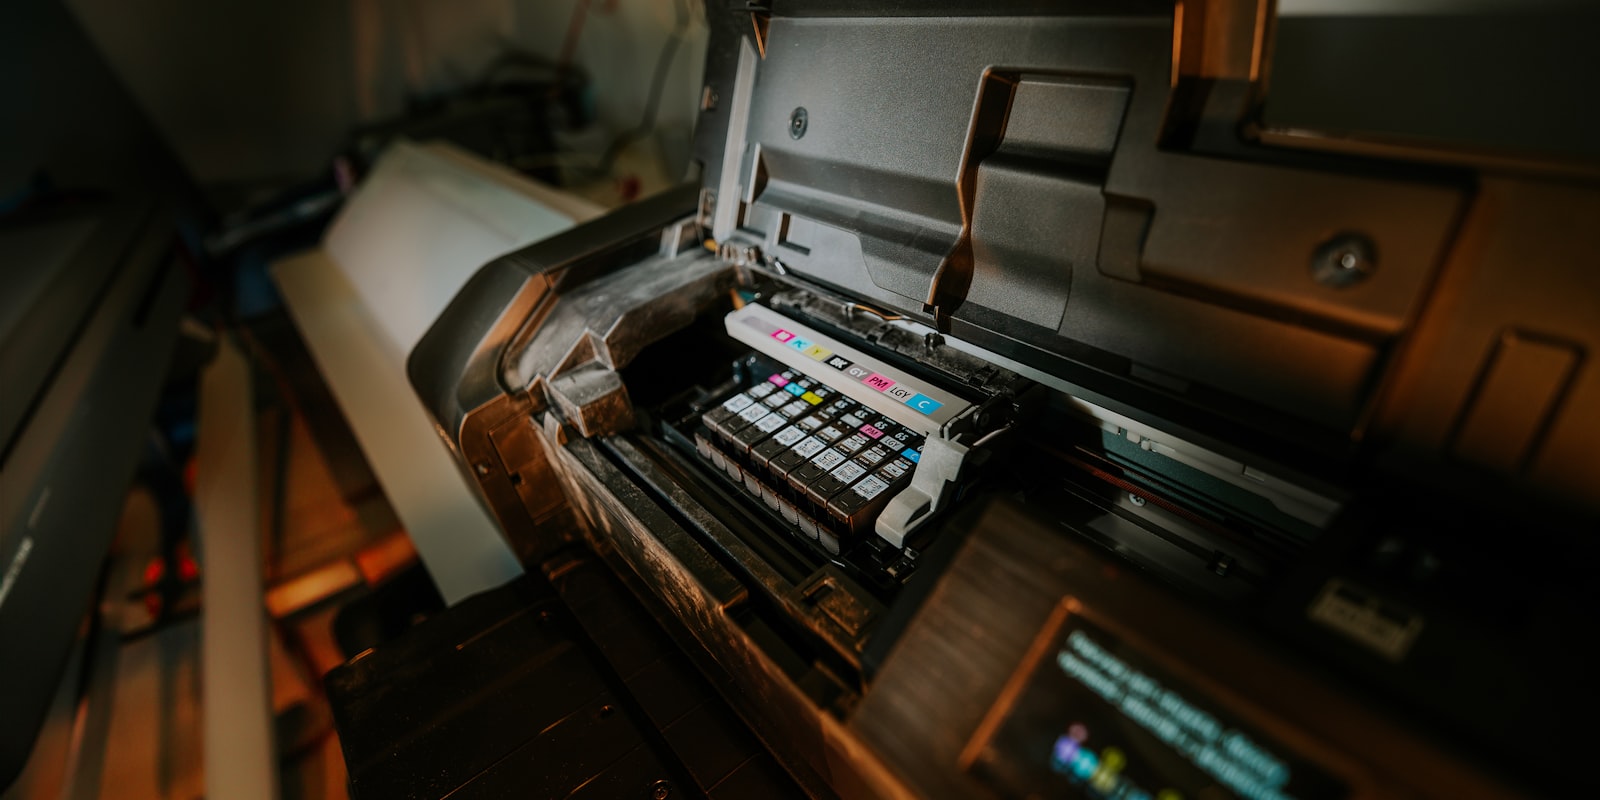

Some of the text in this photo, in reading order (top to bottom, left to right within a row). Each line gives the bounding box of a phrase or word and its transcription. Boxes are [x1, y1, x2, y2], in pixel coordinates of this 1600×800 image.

[829, 357, 848, 369] BK
[849, 367, 869, 378] GY
[868, 376, 888, 389] PM
[890, 386, 911, 399] LGY
[918, 400, 930, 409] C
[834, 400, 848, 409] 65
[854, 410, 868, 419] 65
[874, 421, 888, 430] 65
[865, 427, 878, 436] PM
[895, 432, 909, 441] 65
[884, 438, 900, 448] LGY
